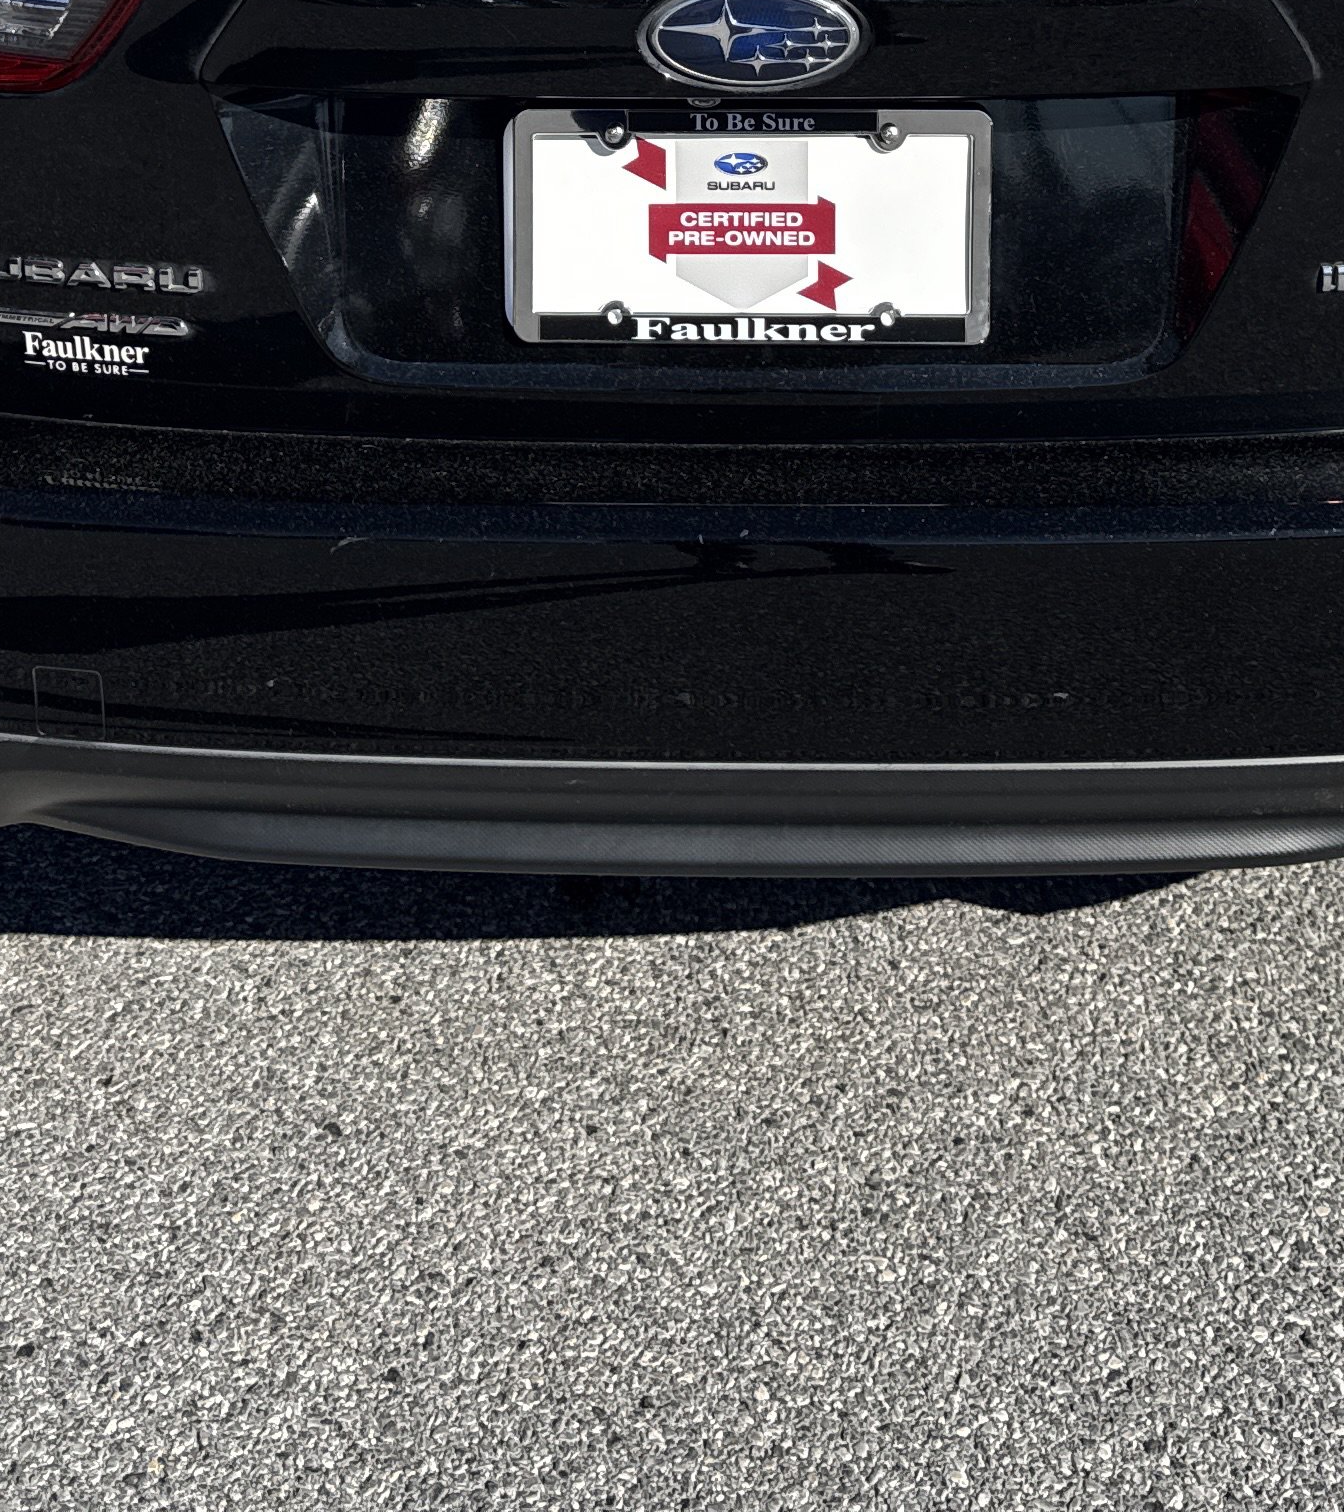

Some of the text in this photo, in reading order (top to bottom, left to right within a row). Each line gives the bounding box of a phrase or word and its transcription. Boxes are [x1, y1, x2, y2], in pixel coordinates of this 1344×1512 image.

[690, 113, 816, 131] To Be Sure
[707, 181, 776, 191] SUBARU
[679, 211, 804, 227] CERTIFIED
[668, 230, 816, 246] PRE-OWNED
[60, 311, 190, 337] AWD
[631, 317, 877, 342] Faulkner
[22, 330, 150, 364] Faulkner
[46, 359, 130, 376] TO BE SURE
